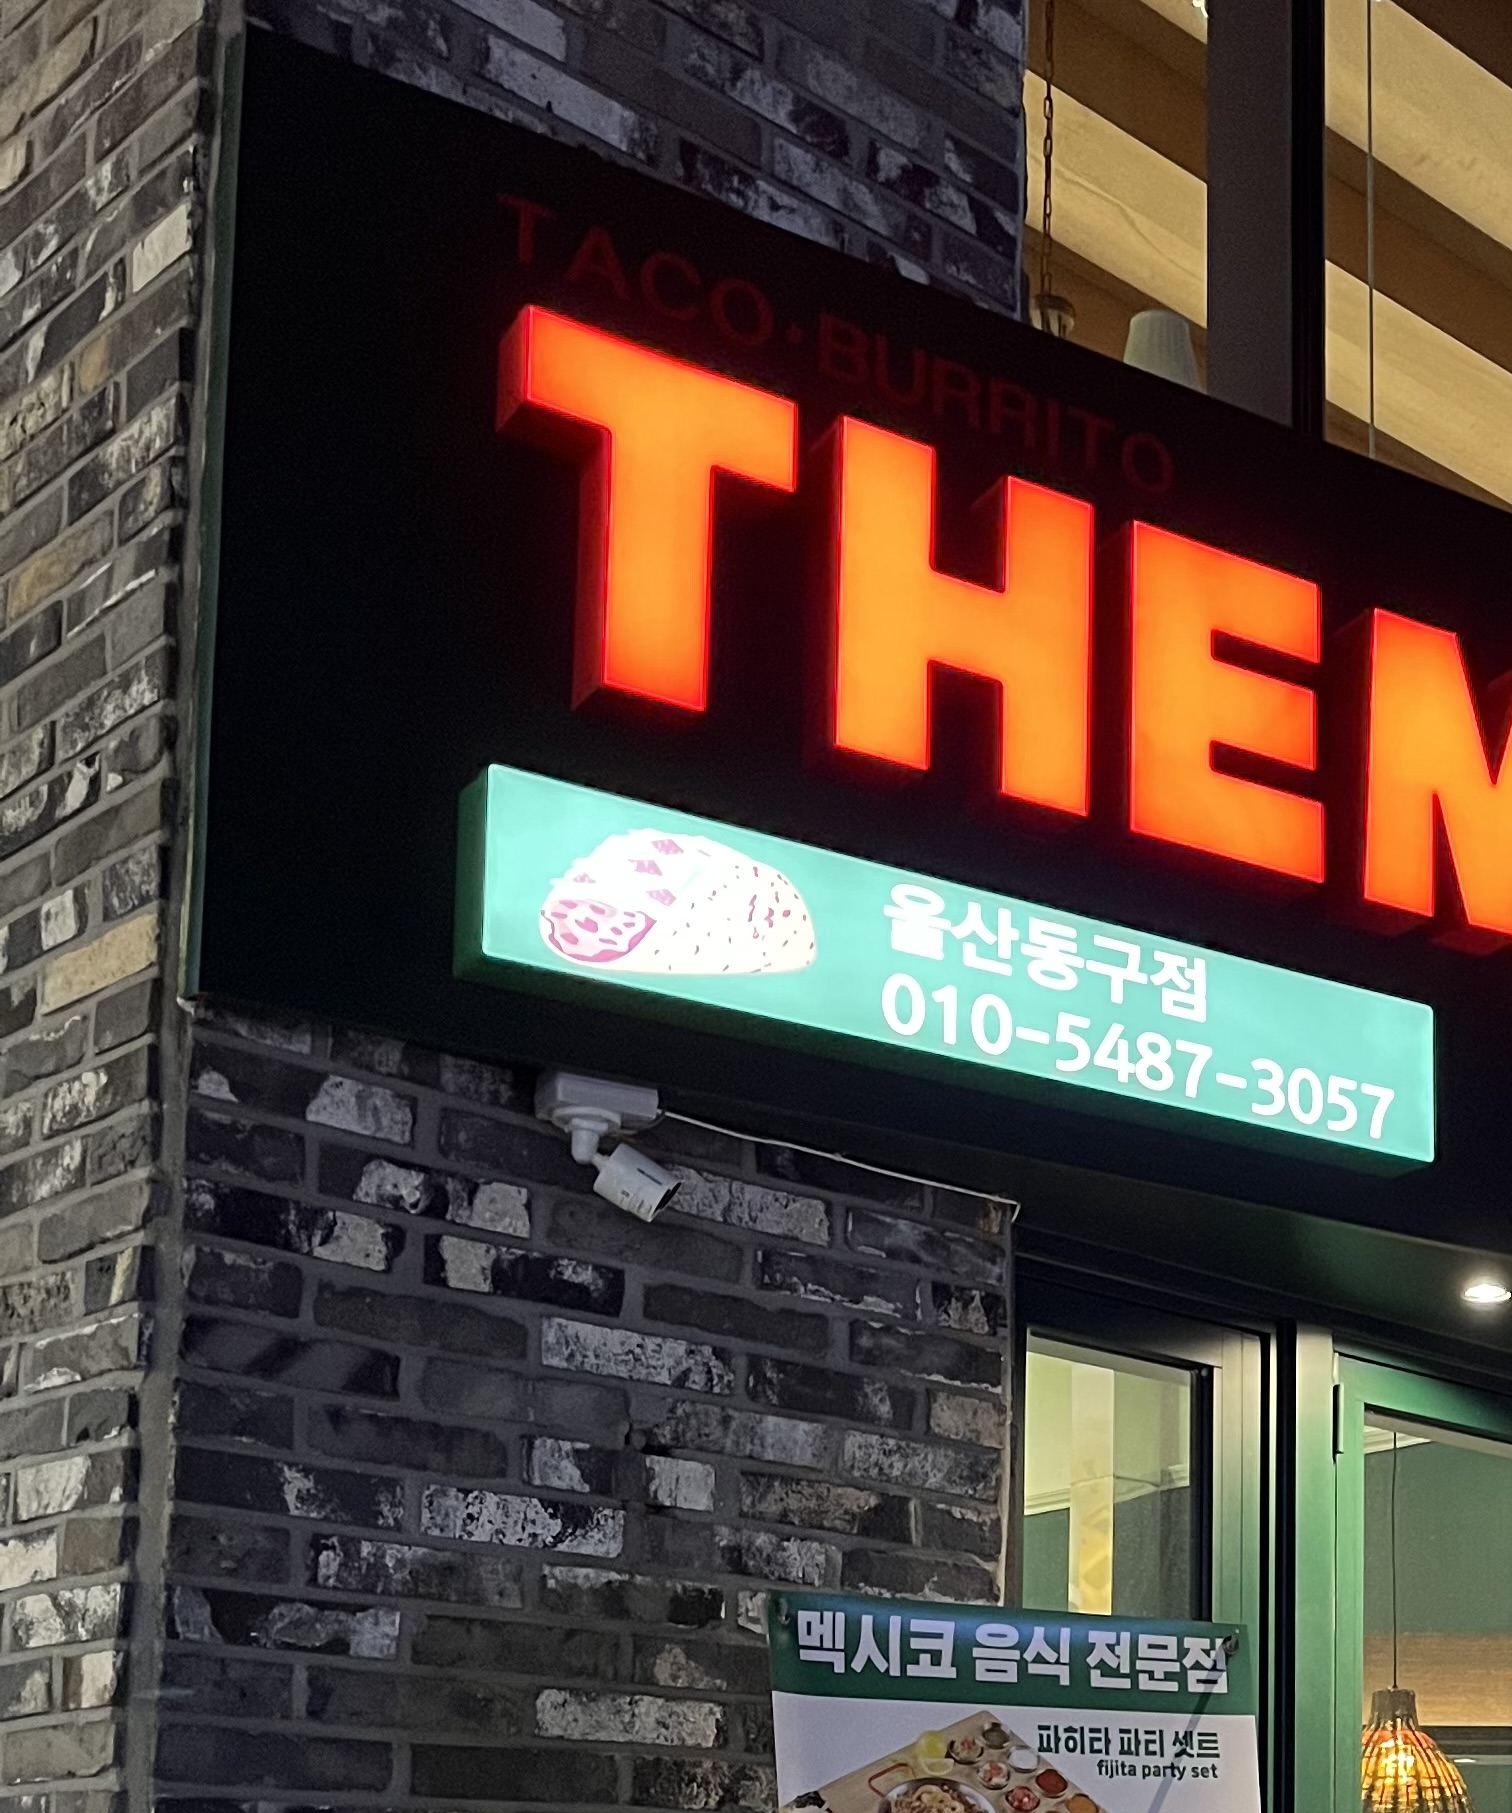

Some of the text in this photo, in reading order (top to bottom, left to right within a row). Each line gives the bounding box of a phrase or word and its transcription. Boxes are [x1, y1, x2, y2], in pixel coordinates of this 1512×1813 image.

[883, 882, 1209, 1024] 울산동구점
[881, 973, 1397, 1142] 010-5487-3057
[798, 1610, 1229, 1694] 멕시코 음식 전문점
[1037, 1724, 1220, 1760] 파히타 파티 셋트
[1097, 1758, 1218, 1781] fijita party set
